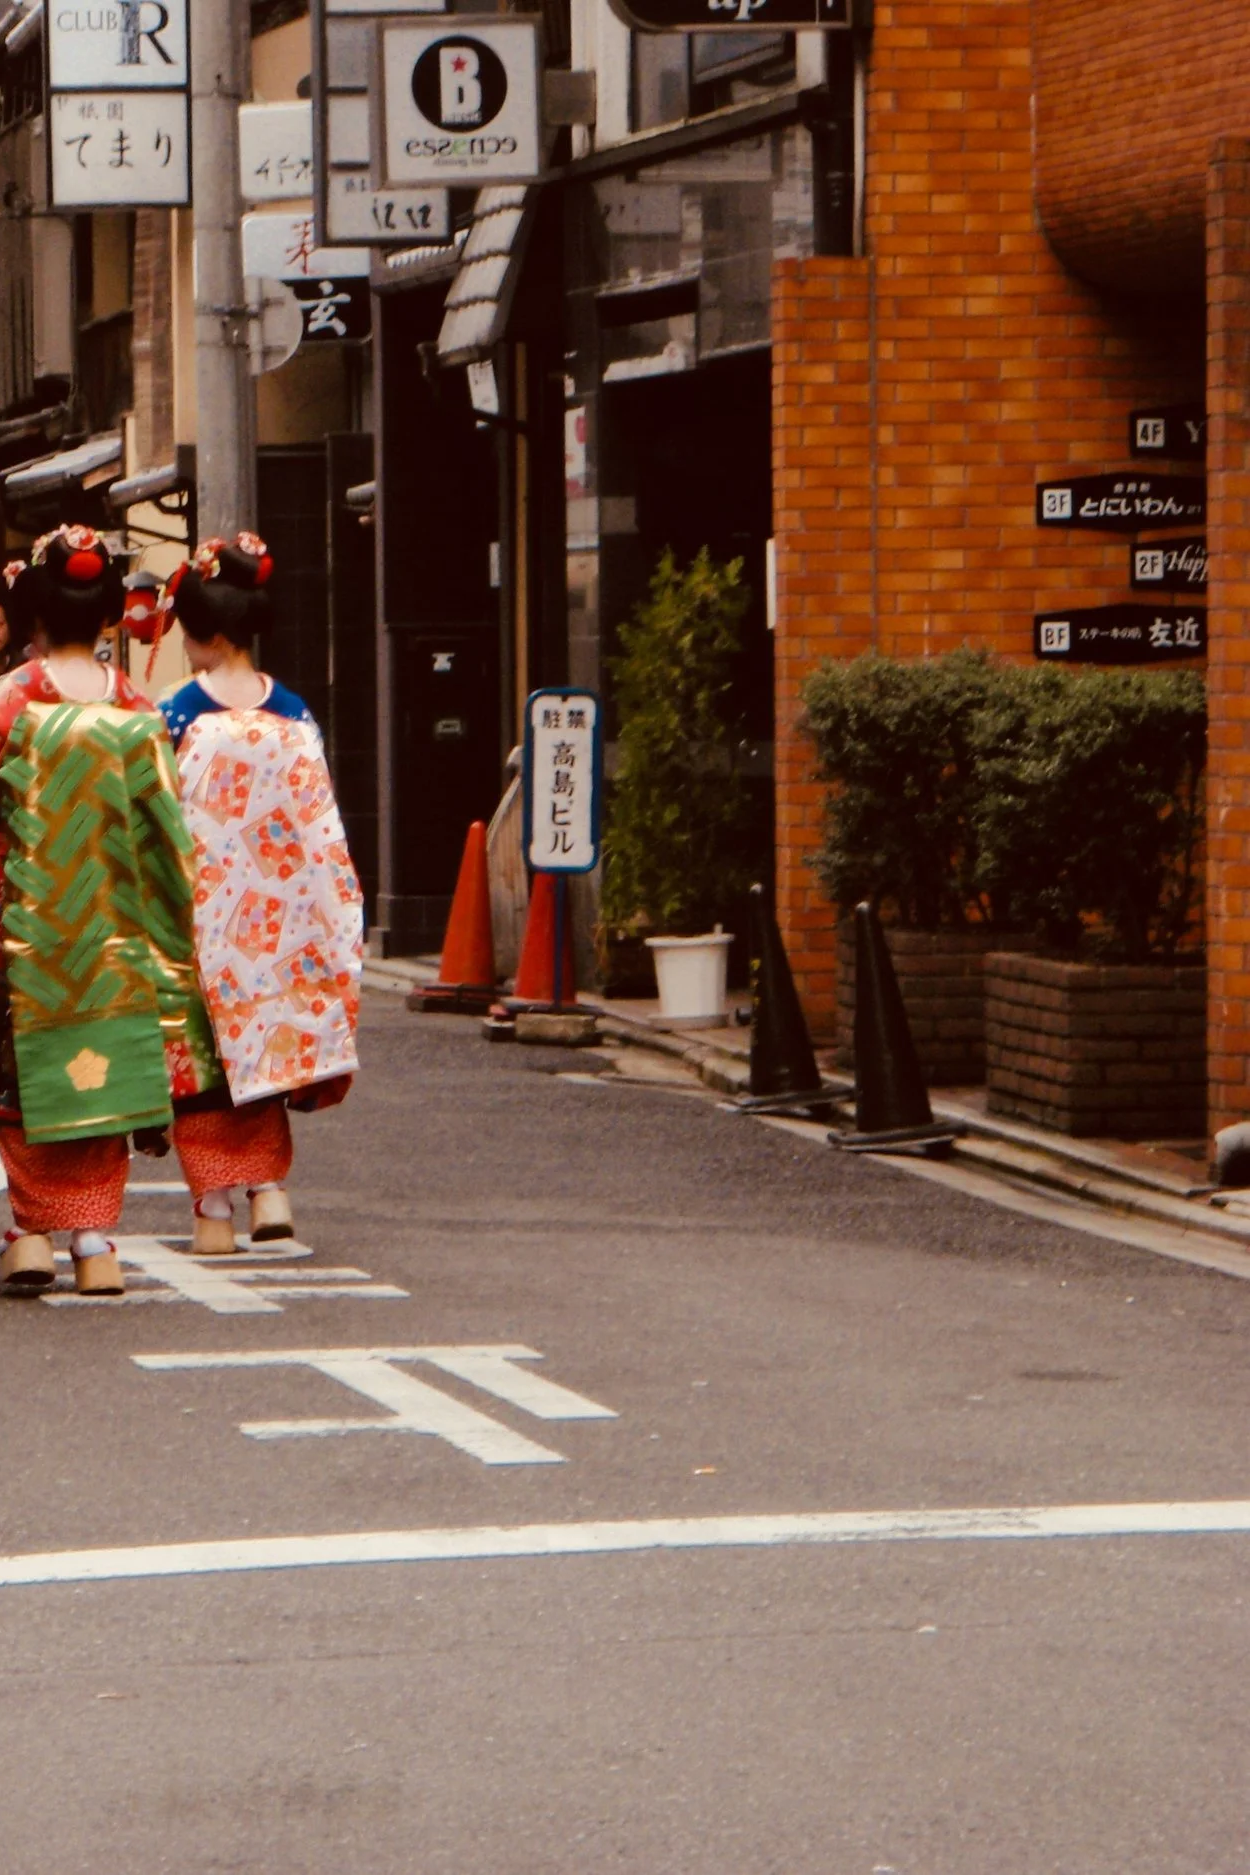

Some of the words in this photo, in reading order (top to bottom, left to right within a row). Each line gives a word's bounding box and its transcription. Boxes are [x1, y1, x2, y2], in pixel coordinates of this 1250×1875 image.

[56, 10, 118, 32] CLUB
[64, 128, 173, 168] てまり
[1139, 422, 1162, 443] 4F
[1045, 493, 1071, 513] 3F
[1079, 497, 1184, 517] とにいわん
[1139, 556, 1161, 576] 2F
[1148, 616, 1201, 648] 左近
[549, 739, 577, 854] 高島ビル
